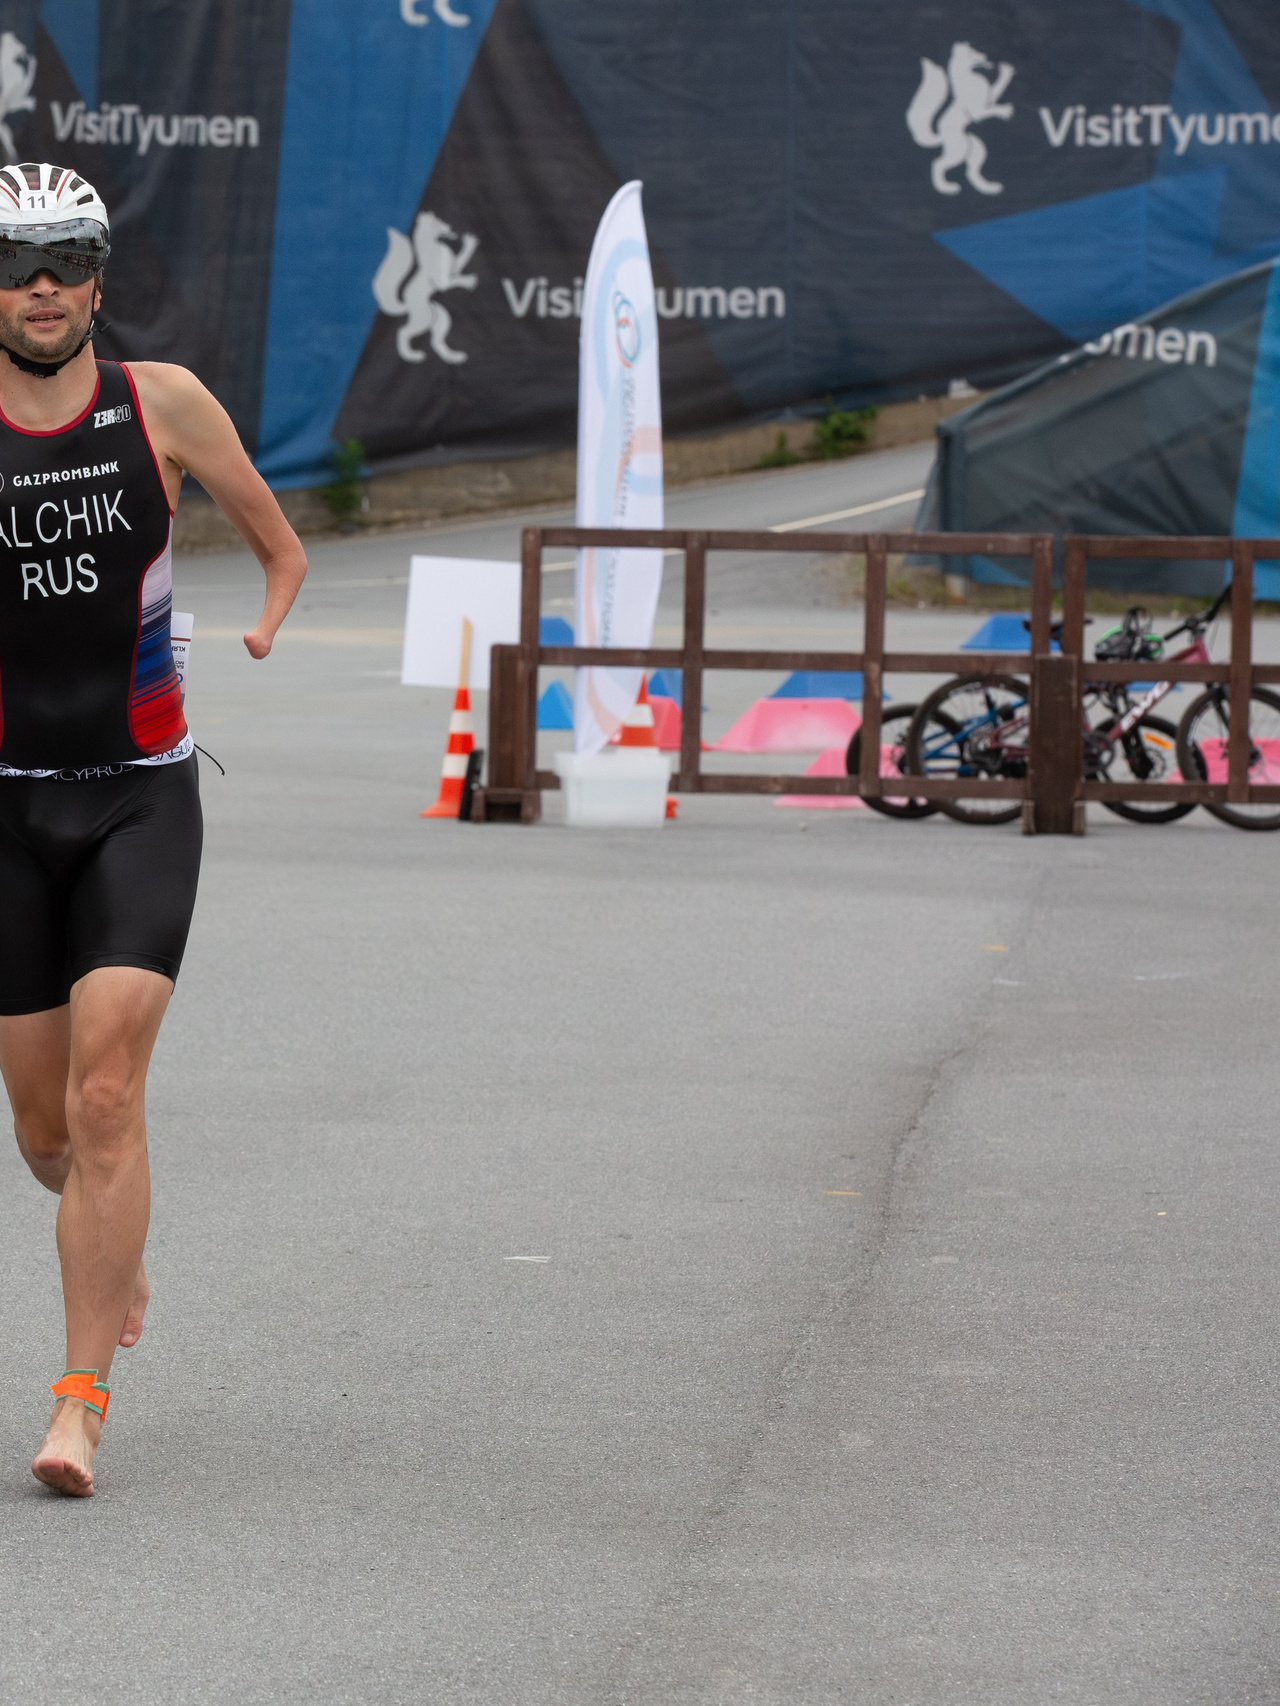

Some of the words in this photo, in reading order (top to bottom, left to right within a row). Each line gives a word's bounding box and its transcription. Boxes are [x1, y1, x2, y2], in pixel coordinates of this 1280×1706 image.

[50, 100, 260, 156] VisitTyumen
[1039, 104, 1280, 155] VisitTyum
[27, 195, 45, 208] 11
[502, 276, 786, 318] Visiumen
[13, 461, 120, 487] GAZPROMBANK
[21, 553, 99, 600] RUS
